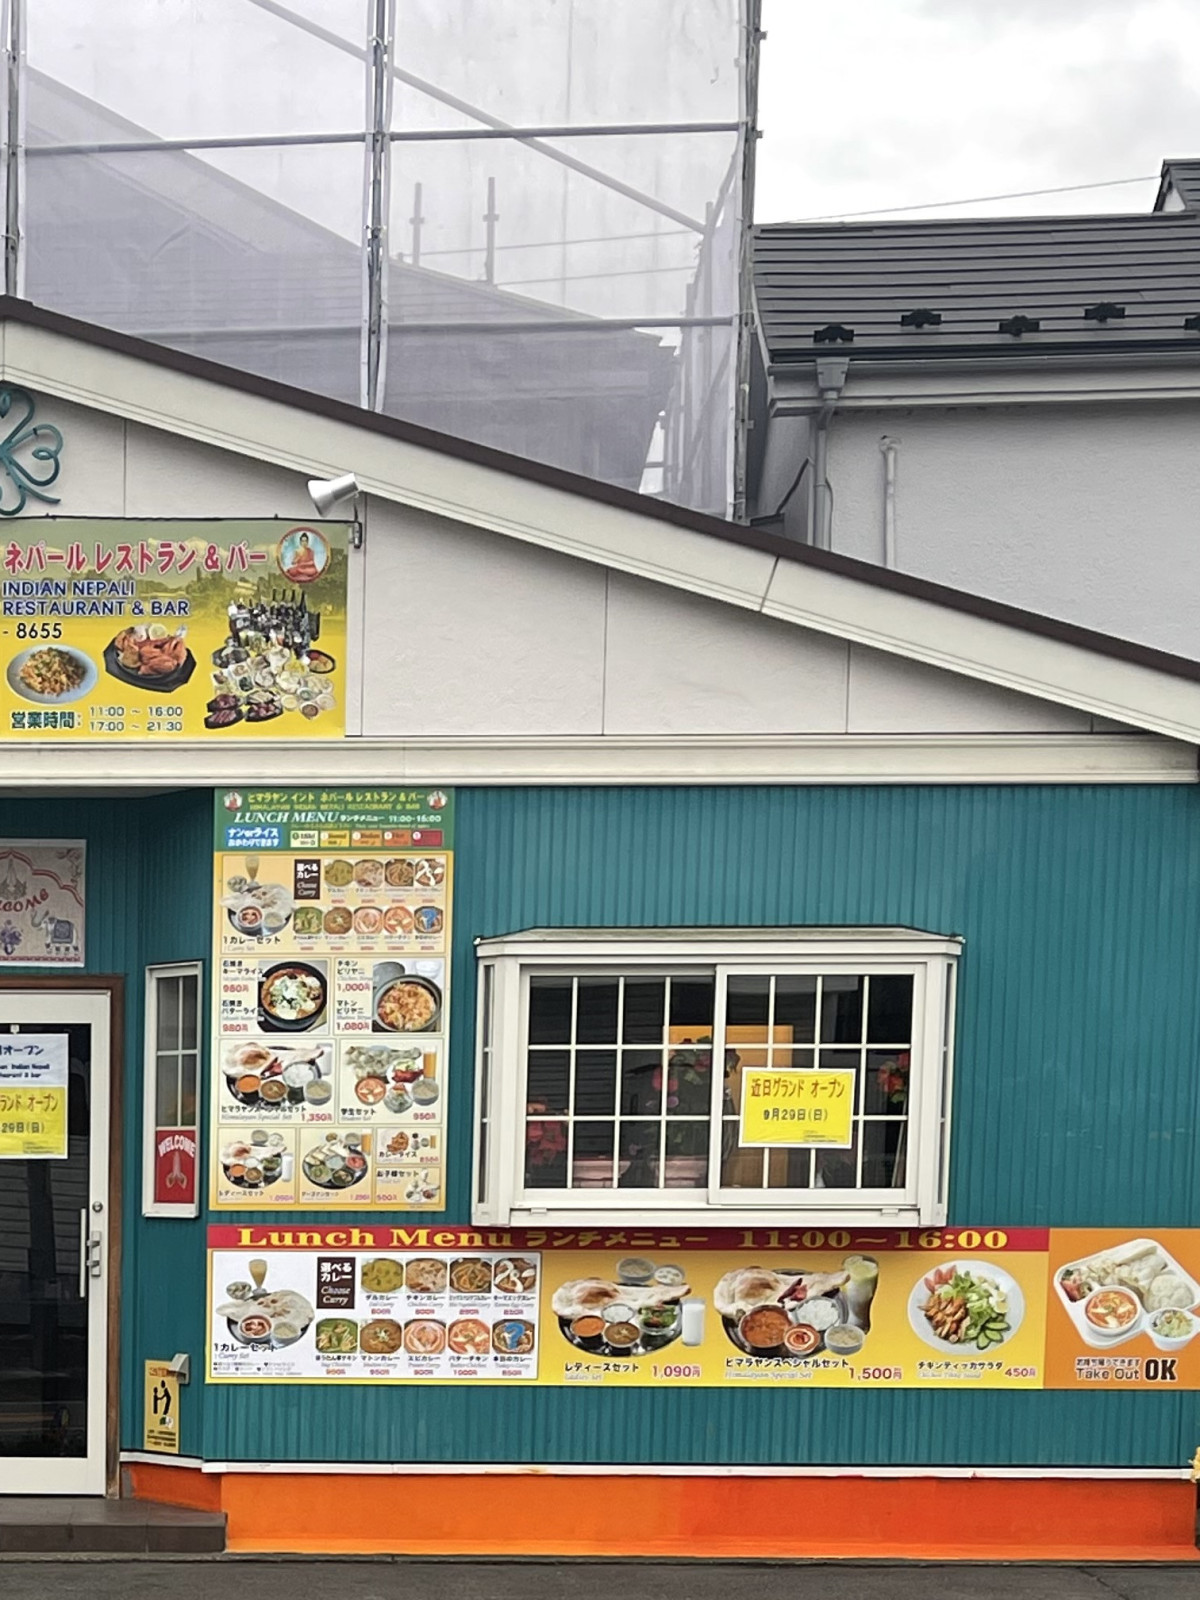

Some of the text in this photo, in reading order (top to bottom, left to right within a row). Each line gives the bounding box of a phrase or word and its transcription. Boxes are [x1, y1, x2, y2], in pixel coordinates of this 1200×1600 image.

[3, 541, 87, 574] ネパール
[95, 541, 197, 574] レストラン
[204, 547, 220, 572] &
[226, 541, 267, 572] バー
[2, 580, 135, 597] INDIAN NEPALI
[2, 600, 190, 616] RESTAURANT & BAR
[15, 622, 63, 639] 8655
[89, 706, 183, 717] 11:00 16:00
[89, 720, 183, 732] 17:00 21:30
[234, 812, 289, 824] LUNCH
[291, 812, 340, 824] MENU
[751, 1077, 845, 1098] 近日グランド オープン
[27, 1093, 59, 1112] オープン
[158, 1134, 197, 1159] WELCOME
[237, 1228, 376, 1247] Lunch
[389, 1228, 514, 1247] Menu
[526, 1231, 709, 1248] ランチメニュー
[320, 1272, 353, 1283] カレー
[214, 1343, 278, 1352] 1カレーセット
[565, 1362, 639, 1372] レディースセット
[725, 1357, 850, 1368] ヒマラヤンスペシャルセット
[1076, 1358, 1178, 1381] Take Out OK
